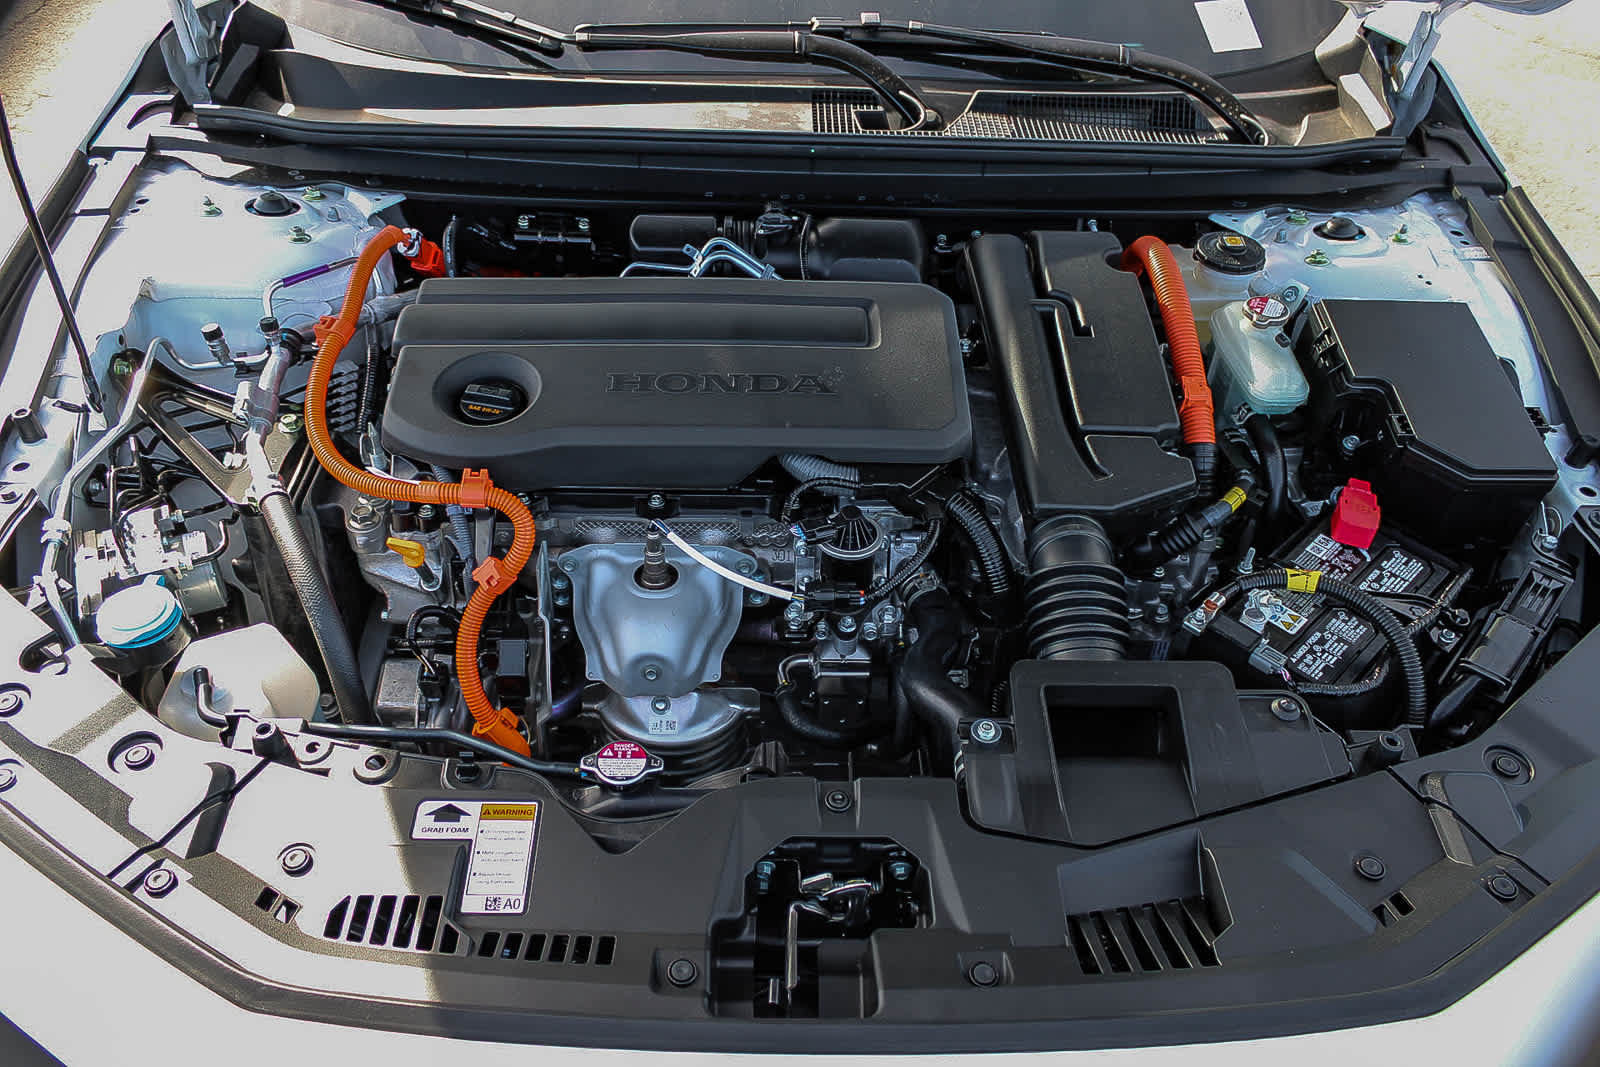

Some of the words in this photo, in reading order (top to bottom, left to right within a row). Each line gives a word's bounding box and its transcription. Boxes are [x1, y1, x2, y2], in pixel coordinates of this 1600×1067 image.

[605, 371, 838, 395] HONDA
[492, 808, 533, 816] WARNING
[502, 898, 521, 910] A0
